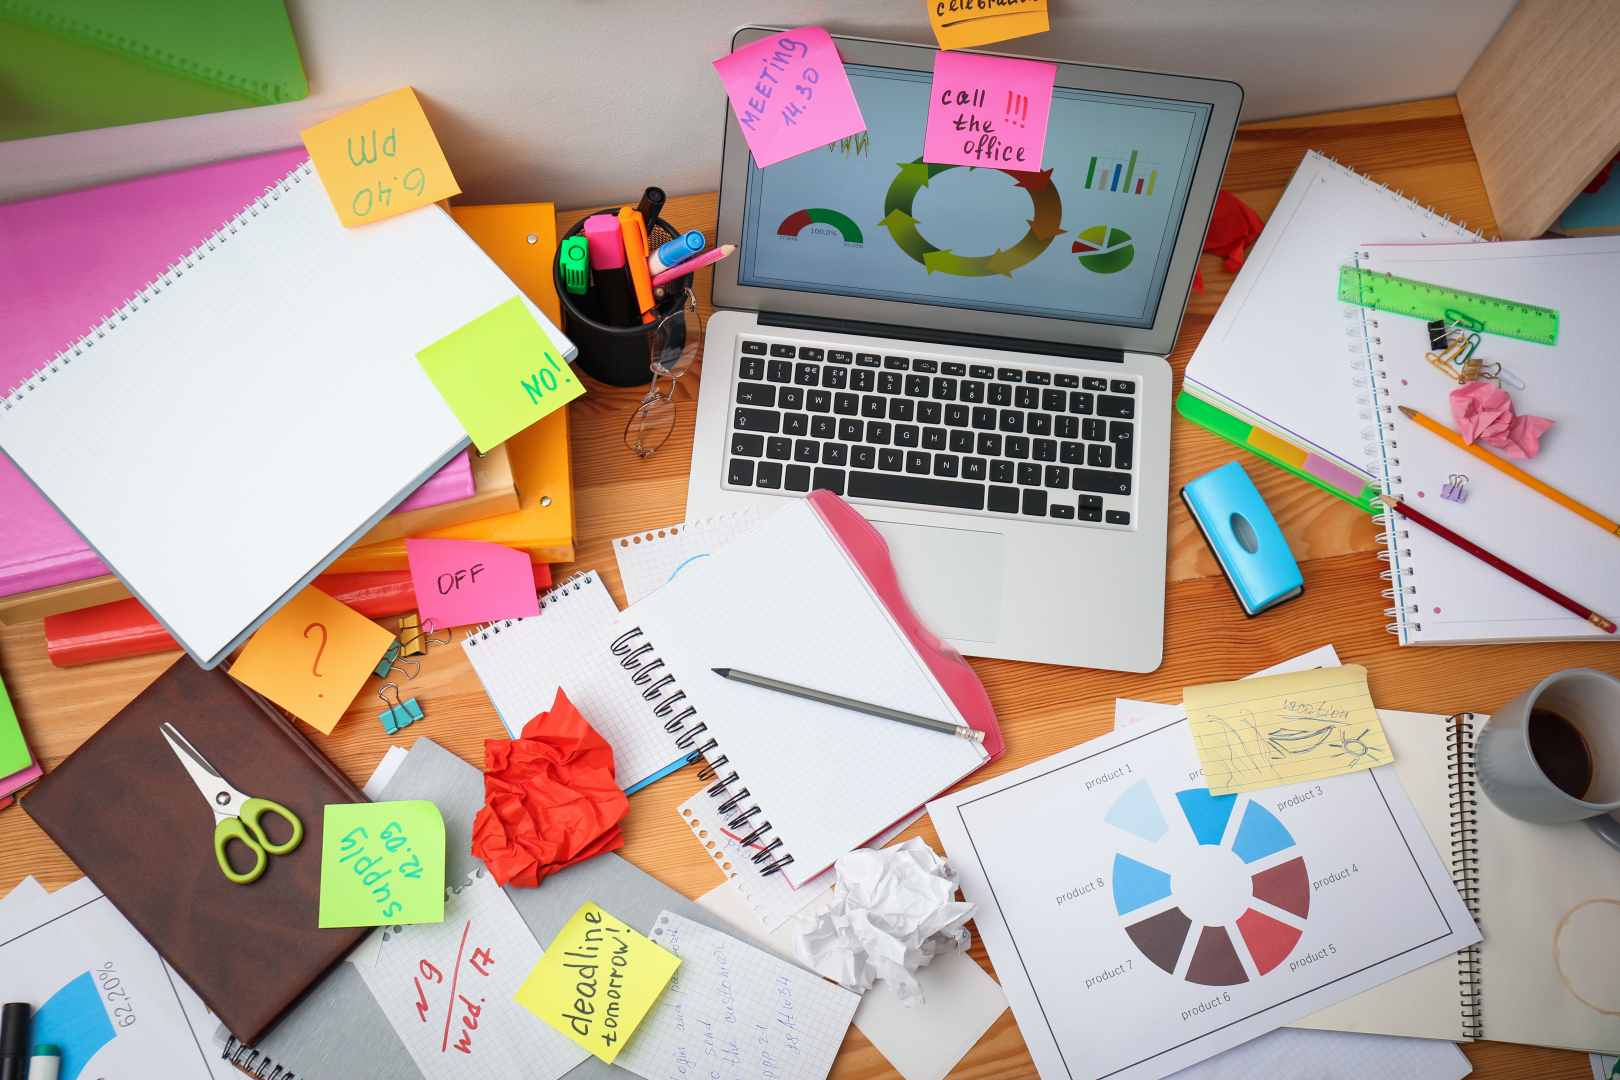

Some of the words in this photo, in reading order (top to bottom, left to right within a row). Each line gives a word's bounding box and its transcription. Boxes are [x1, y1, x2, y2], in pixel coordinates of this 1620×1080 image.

[941, 89, 985, 108] call
[953, 113, 995, 133] the
[963, 134, 1026, 162] office
[787, 394, 795, 402] Q
[926, 408, 932, 416] Y
[954, 411, 960, 419] U
[804, 447, 810, 455] Z
[860, 453, 866, 461] C
[931, 434, 938, 442] H
[986, 440, 993, 448] K
[1015, 443, 1020, 451] L
[437, 563, 485, 595] OFF
[1283, 699, 1351, 720] vacation
[1085, 768, 1124, 790] product
[1127, 764, 1132, 773] 1
[1277, 790, 1314, 811] product
[1315, 786, 1323, 796] 3
[339, 826, 403, 917] supply
[1313, 868, 1351, 890] product
[1351, 864, 1359, 874] 4
[1055, 881, 1096, 905] product
[1097, 878, 1104, 887] 8
[1288, 948, 1328, 971] product
[1328, 945, 1337, 955] 5
[561, 910, 603, 1036] deadline
[713, 942, 737, 1024] customer
[1085, 964, 1126, 988] product
[1126, 960, 1133, 969] 7
[664, 1003, 686, 1031] and
[1181, 997, 1221, 1021] product
[1223, 992, 1231, 1002] 6
[696, 1019, 717, 1057] send
[721, 1039, 741, 1066] the
